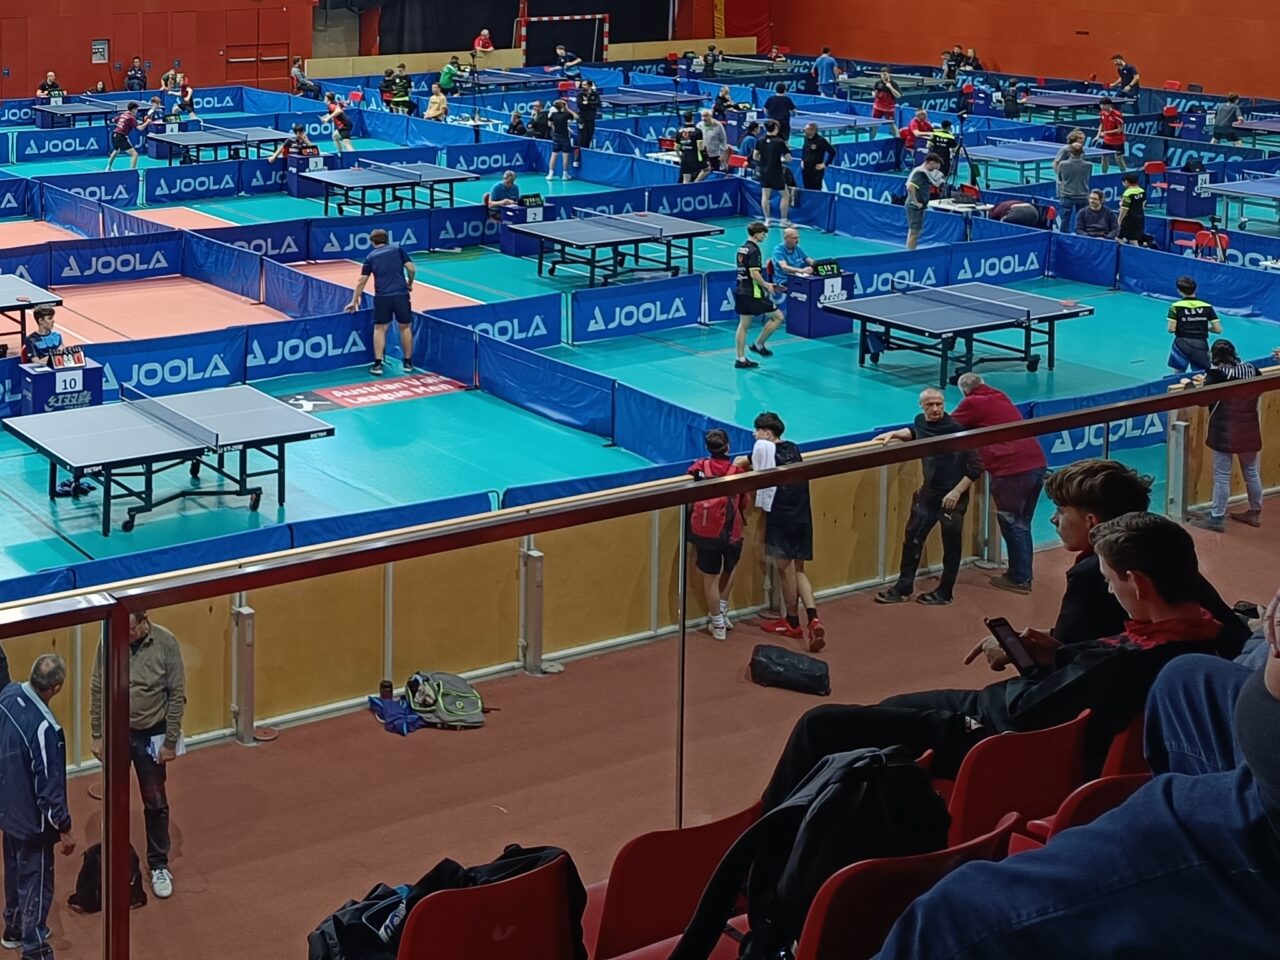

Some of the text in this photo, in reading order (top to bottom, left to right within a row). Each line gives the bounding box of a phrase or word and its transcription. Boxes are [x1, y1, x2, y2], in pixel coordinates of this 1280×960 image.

[632, 64, 666, 75] ICTAS
[193, 96, 234, 109] OOLA
[0, 107, 36, 122] JOOL
[304, 123, 335, 137] JOOL
[40, 136, 100, 153] JOOLA
[470, 152, 524, 170] JOOLA
[850, 149, 896, 166] JOOLA
[67, 184, 131, 201] OOLA
[171, 174, 236, 194] JOOLA
[835, 182, 892, 204] JOOLA
[673, 192, 733, 212] JOOLA
[531, 212, 537, 221] 2
[344, 227, 418, 251] JOLA
[457, 220, 502, 238] JOOL
[228, 235, 300, 257] OOLA
[84, 250, 169, 275] JOOLA
[817, 264, 838, 275] 5 7
[975, 251, 1039, 277] JOOLA
[865, 267, 937, 293] JOOLA
[608, 297, 687, 328] JOOLA
[472, 314, 548, 342] OOLA
[268, 330, 367, 365] JOOLA
[120, 353, 231, 388] JOOLA
[62, 378, 77, 391] 10
[330, 377, 409, 398] Austrian
[345, 381, 454, 405] League Men
[1075, 412, 1165, 451] JOOLA
